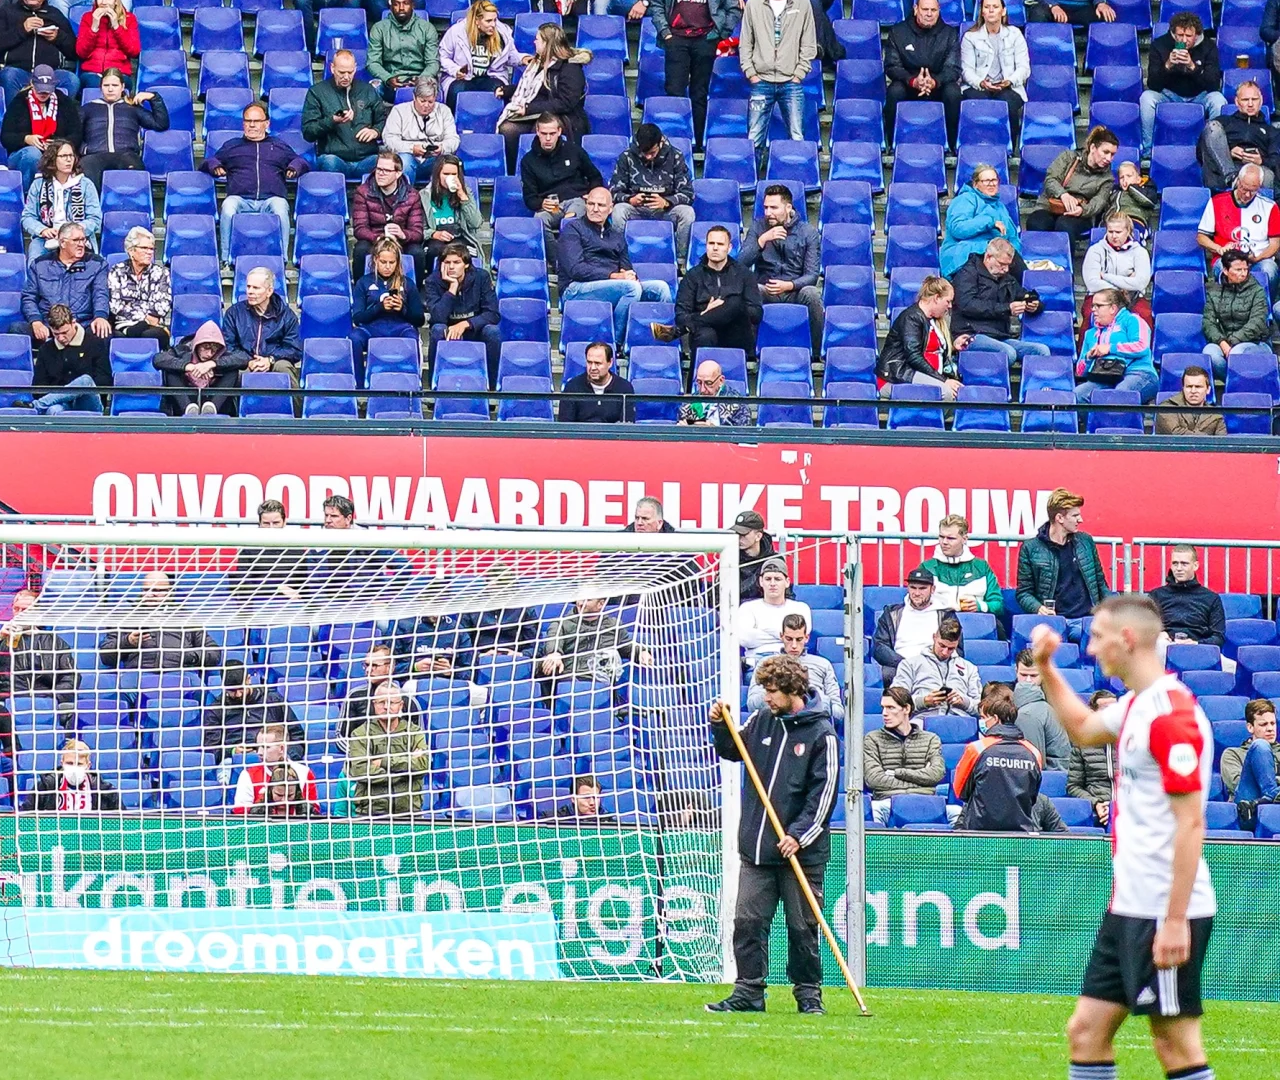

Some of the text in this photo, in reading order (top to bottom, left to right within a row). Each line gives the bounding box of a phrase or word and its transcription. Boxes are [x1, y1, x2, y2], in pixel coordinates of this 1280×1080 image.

[435, 216, 454, 226] roo
[93, 472, 1053, 546] ONVOORWAARDELIJKE TROUW
[985, 755, 1037, 773] SECURITY
[501, 858, 705, 966] eige
[833, 866, 1020, 951] and
[83, 916, 536, 977] droomparken
